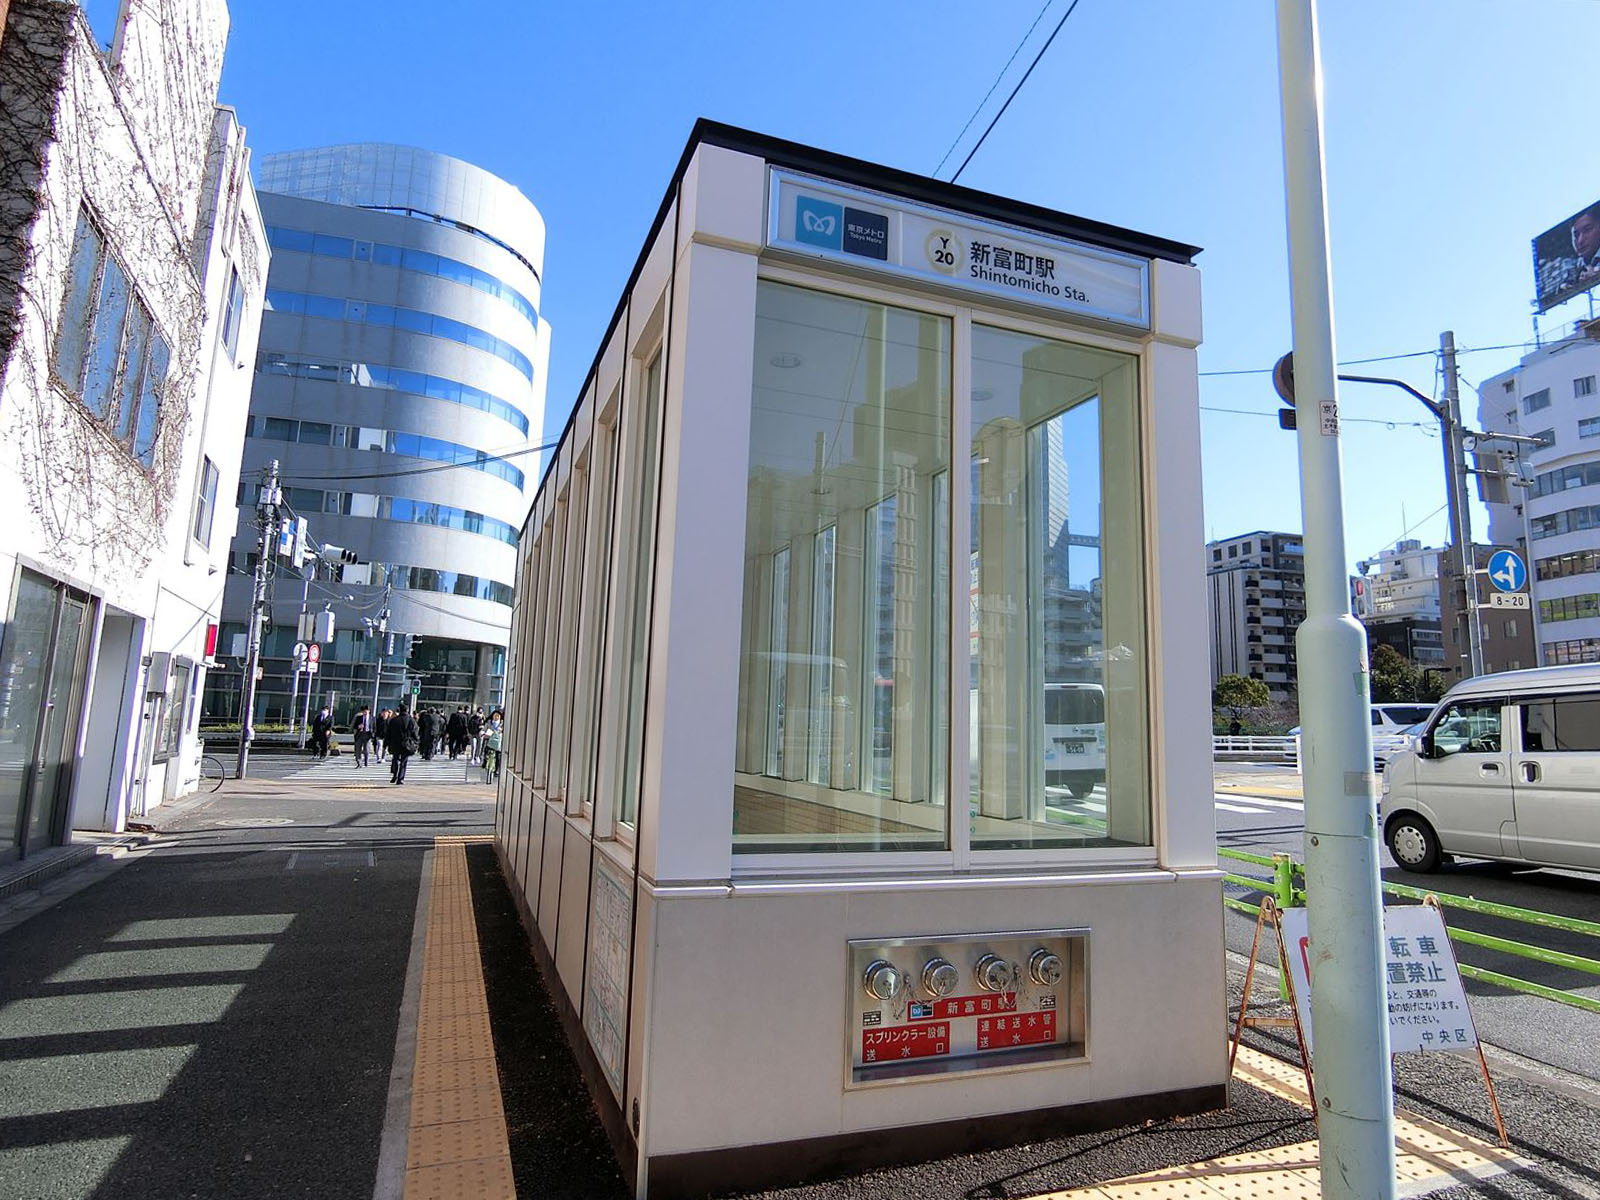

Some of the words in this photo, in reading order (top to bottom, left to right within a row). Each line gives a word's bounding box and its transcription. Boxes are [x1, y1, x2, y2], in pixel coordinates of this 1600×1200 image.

[848, 224, 885, 239] 東京メトロ
[850, 232, 866, 241] Tokyo
[866, 236, 882, 244] Metro
[940, 237, 950, 249] Y
[935, 250, 954, 265] 20
[970, 241, 1055, 280] 新富町駅
[970, 264, 1060, 296] Shintomicho
[1065, 286, 1090, 302] Sta.
[1387, 960, 1447, 984] 置禁止
[866, 1025, 946, 1044] スプリンクラー設備
[1422, 1028, 1467, 1044] 中央区
